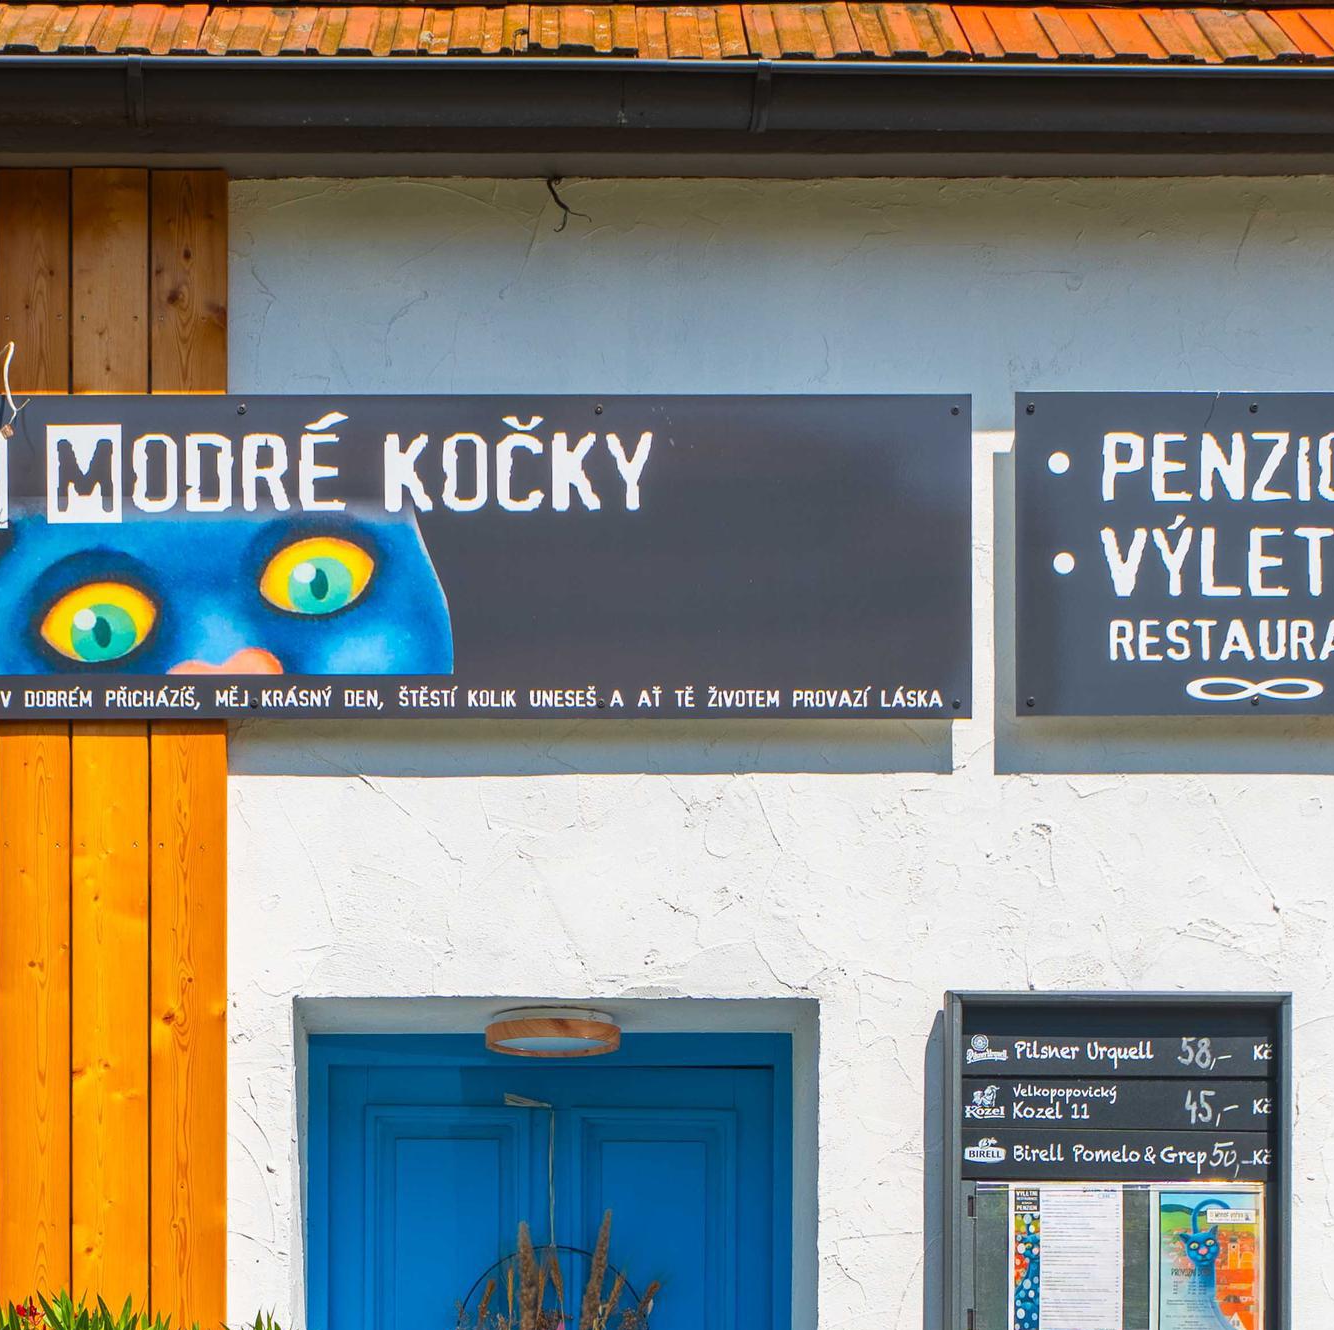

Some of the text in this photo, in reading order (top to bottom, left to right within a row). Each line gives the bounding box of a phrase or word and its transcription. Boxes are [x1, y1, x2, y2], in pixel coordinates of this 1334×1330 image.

[51, 411, 349, 516] MODRÉ
[383, 415, 654, 513] KOČKY
[0, 690, 12, 708] V
[24, 686, 93, 708] DOBRÉM
[104, 685, 201, 711] PŘICHÁZÍŠ,
[215, 686, 249, 708] MĚJ
[261, 686, 332, 708] KRÁSNÝ
[344, 689, 384, 710] DEN,
[398, 686, 459, 708] ŠTĚSTÍ
[467, 690, 517, 708] KOLIK
[529, 686, 598, 708] UNESEŠ
[609, 690, 625, 708] A
[637, 686, 663, 708] AŤ
[674, 686, 695, 708] TĚ
[707, 686, 780, 708] ŽIVOTEM
[792, 686, 872, 708] PROVAZÍ
[880, 686, 944, 708] LÁSKA
[1014, 1040, 1079, 1060] Pilsner
[1086, 1040, 1154, 1069] Urquell
[1253, 1043, 1273, 1061] Kč
[1012, 1083, 1117, 1104] Velkopopovický
[965, 1105, 1005, 1119] Kozel
[1012, 1101, 1090, 1120] Kozel 11
[1252, 1098, 1273, 1115] Kč
[968, 1149, 1003, 1159] BIRELL
[1013, 1143, 1065, 1161] Birell
[1072, 1144, 1141, 1163] Pomelo
[1143, 1145, 1156, 1164] &
[1160, 1146, 1207, 1174] Grep
[1253, 1148, 1272, 1165] Kč
